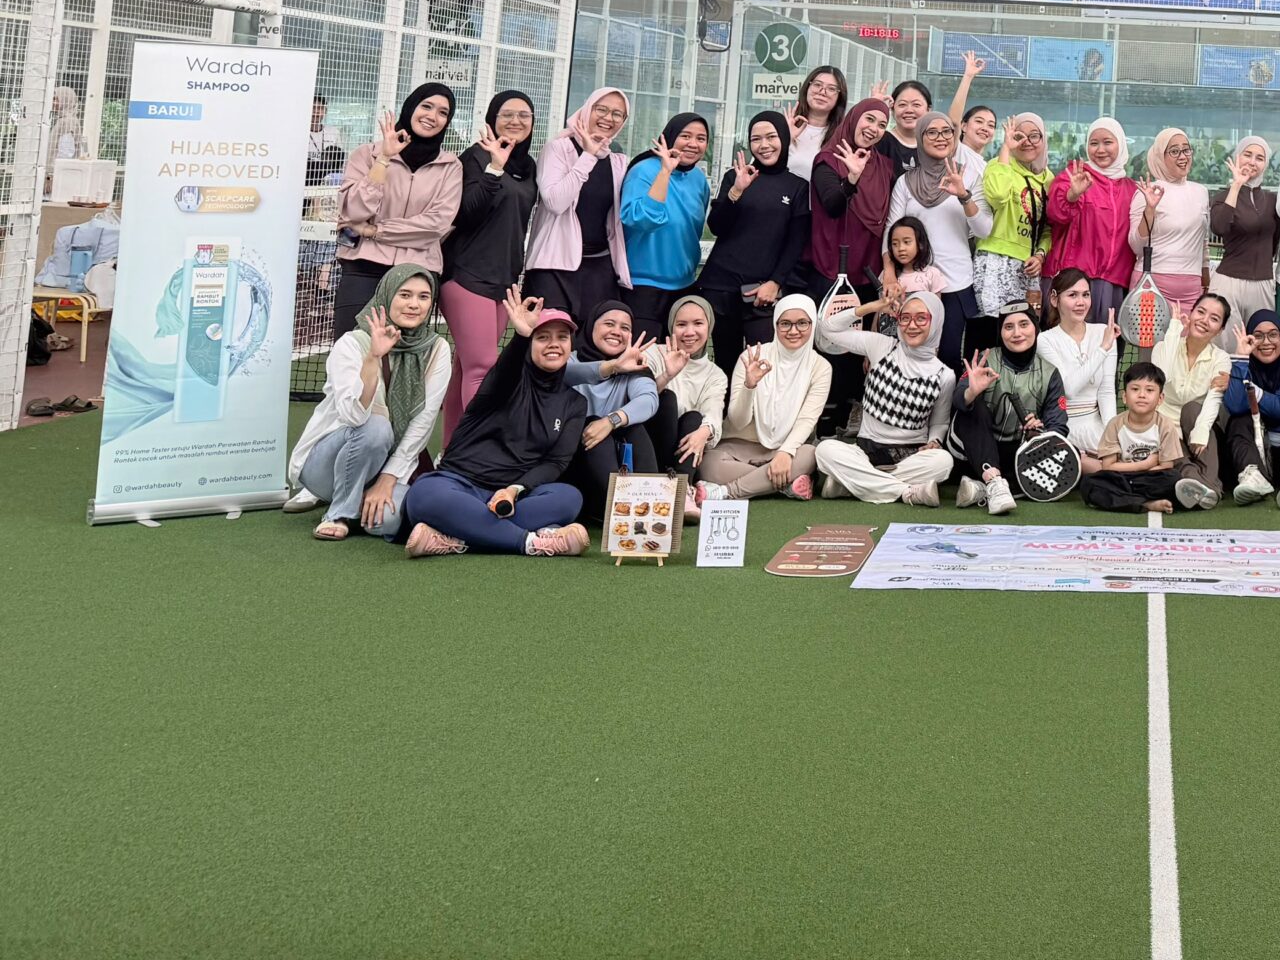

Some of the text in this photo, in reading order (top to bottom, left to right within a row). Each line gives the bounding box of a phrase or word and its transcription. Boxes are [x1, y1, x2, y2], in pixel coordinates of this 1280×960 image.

[772, 34, 790, 62] 3
[187, 81, 250, 93] SHAMPOO
[148, 104, 193, 117] BARU!
[171, 140, 269, 157] HIJABERS
[158, 162, 280, 179] APPROVED!
[205, 195, 256, 203] SCALPCARE
[125, 473, 272, 492] @wardahbeauty wardahbeauty.com
[1024, 542, 1125, 551] MOM'S
[1134, 544, 1219, 553] PADEL
